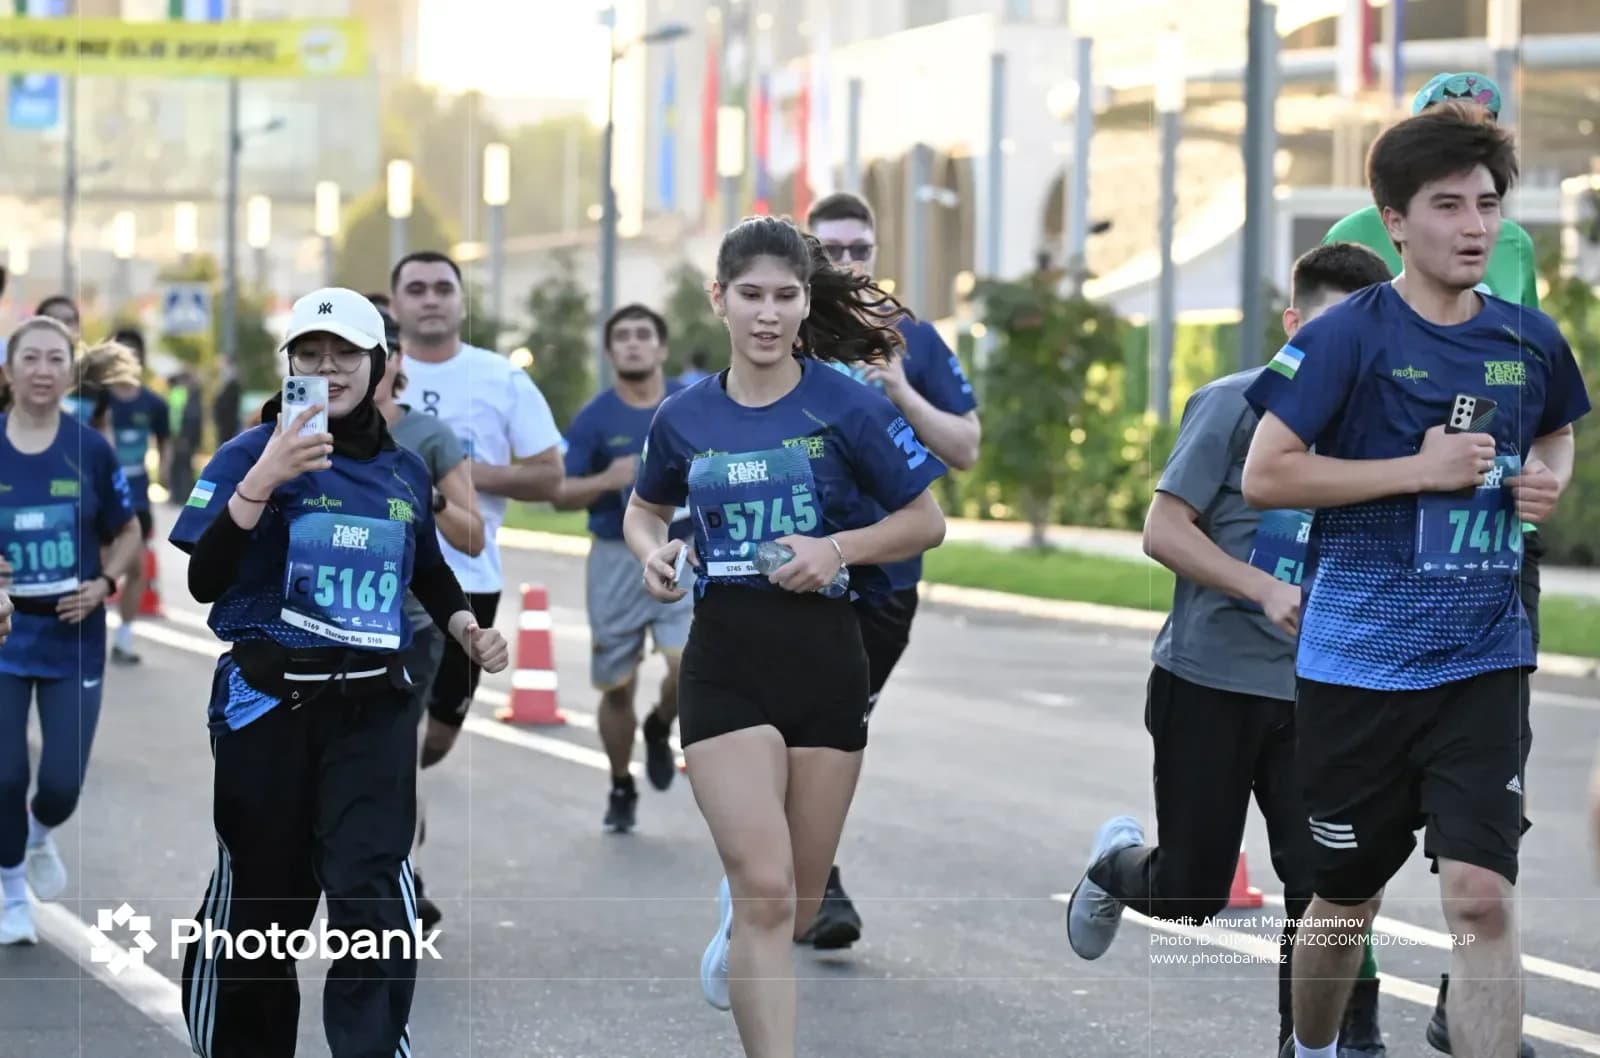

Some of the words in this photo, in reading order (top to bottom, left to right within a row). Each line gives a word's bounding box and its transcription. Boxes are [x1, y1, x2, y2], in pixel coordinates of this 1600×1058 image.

[727, 459, 767, 474] TASH
[728, 469, 766, 482] KENT
[791, 483, 809, 495] 5K
[723, 492, 817, 541] 5745
[332, 533, 367, 546] KENT
[333, 524, 369, 540] TASH
[383, 560, 397, 572] 5K
[314, 564, 398, 614] 5169
[303, 620, 320, 631] 5169
[325, 628, 349, 641] Storage
